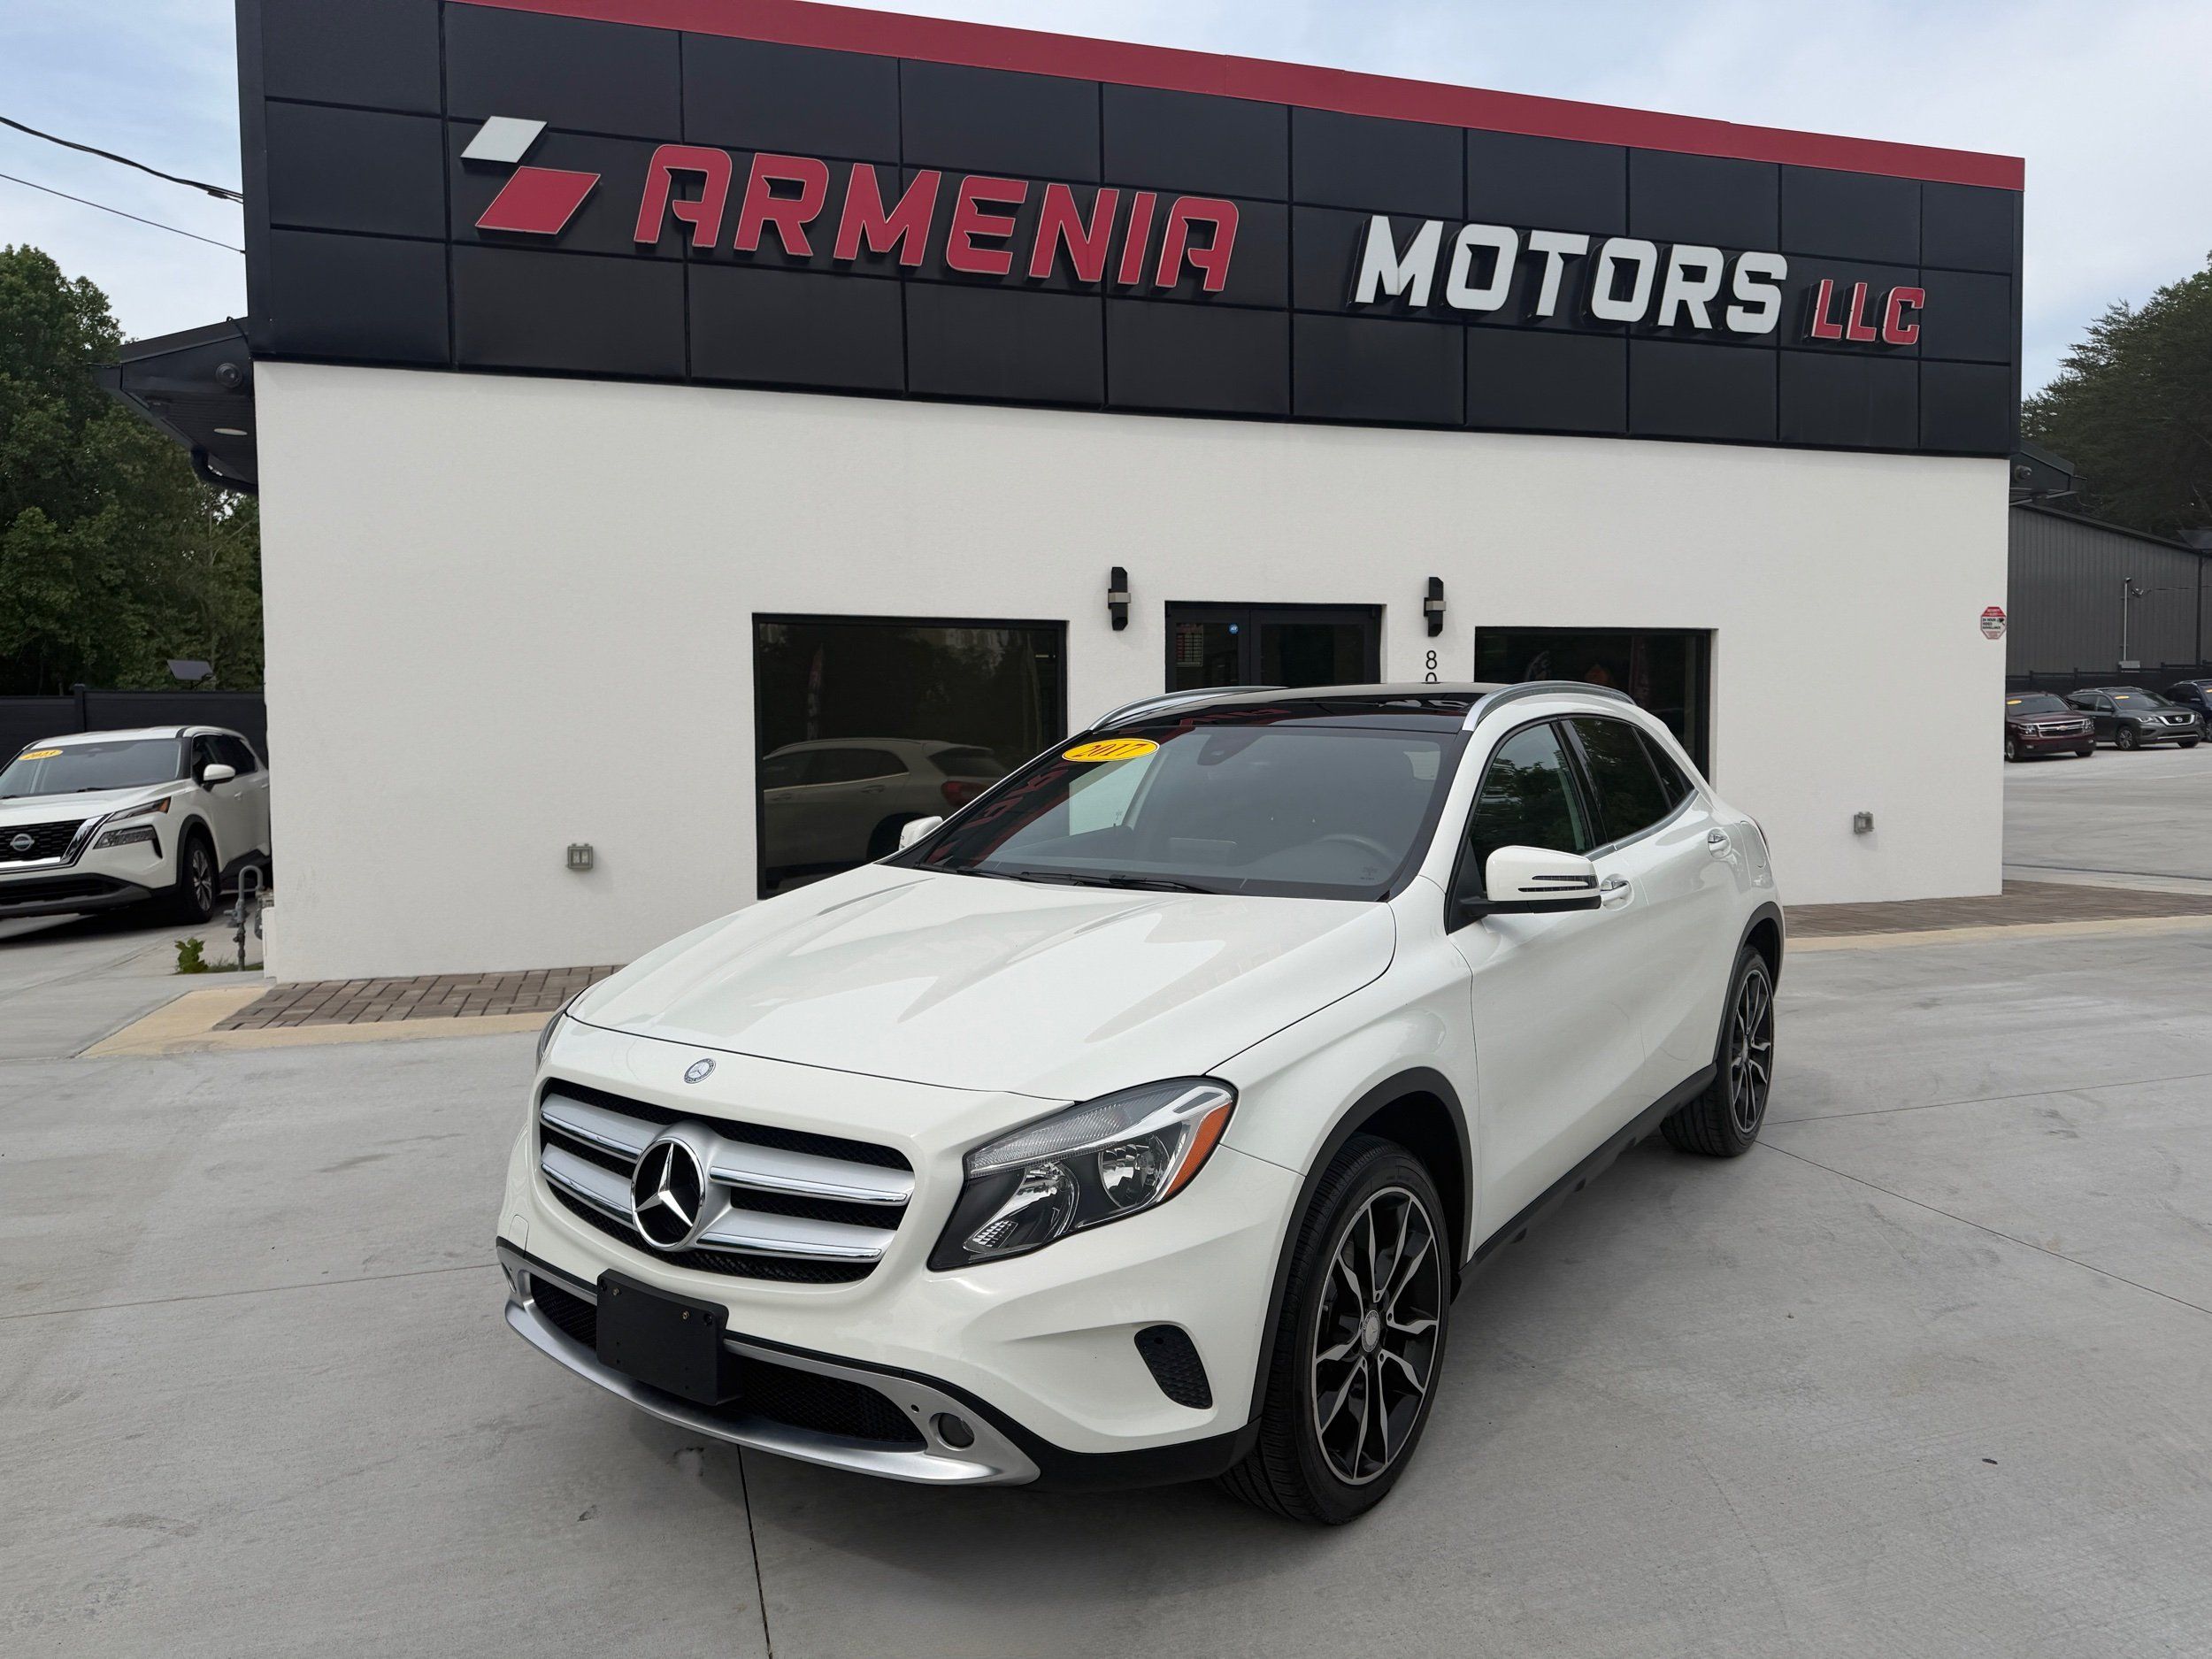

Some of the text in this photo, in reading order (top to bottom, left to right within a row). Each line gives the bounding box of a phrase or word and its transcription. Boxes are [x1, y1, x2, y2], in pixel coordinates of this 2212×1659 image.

[634, 143, 1926, 346] ARMENIA MOTORS LLC
[1071, 743, 1148, 758] 2017
